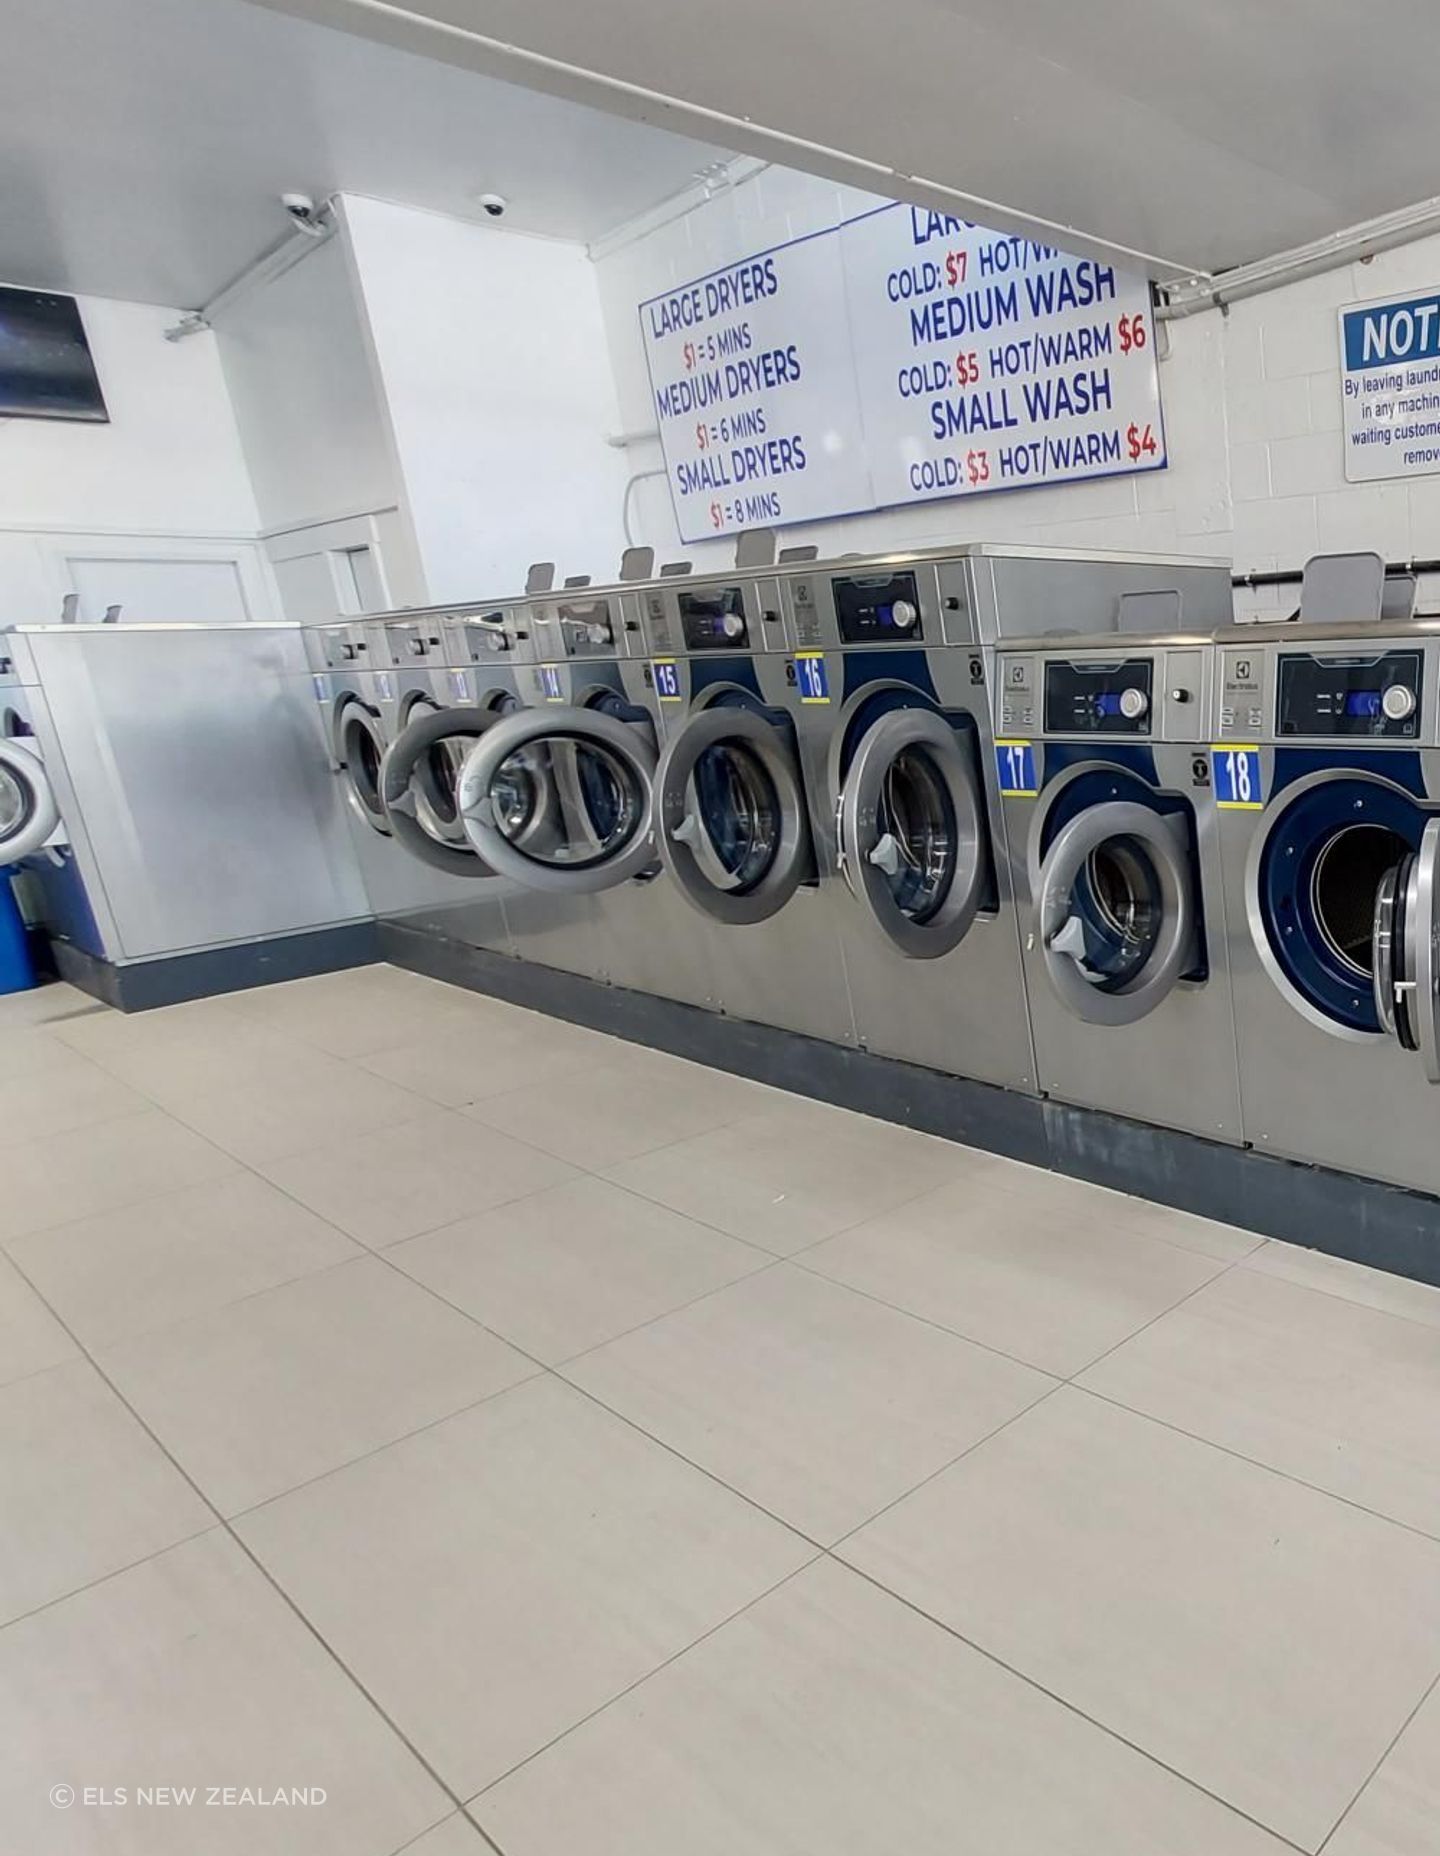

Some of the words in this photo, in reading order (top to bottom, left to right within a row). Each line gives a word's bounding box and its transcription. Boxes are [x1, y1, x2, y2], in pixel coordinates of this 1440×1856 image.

[650, 289, 703, 339] LARGE
[706, 258, 778, 317] DRYERS
[887, 263, 942, 302] COLD:
[946, 251, 967, 291] $7
[911, 282, 1019, 347] MEDIUM
[1025, 261, 1116, 317] WASH
[684, 343, 697, 370] $1
[707, 336, 716, 361] 5
[718, 322, 752, 358] MINS
[898, 360, 952, 397] COLD:
[956, 351, 979, 388] $5
[989, 322, 1112, 379] HOT/WARM
[1118, 313, 1146, 355] $6
[656, 374, 722, 420] MEDIUM
[726, 345, 801, 399] DRYERS
[931, 388, 1018, 440] SMALL
[1023, 367, 1112, 423] WASH
[1345, 379, 1359, 398] By
[1363, 373, 1403, 393] leaving
[696, 423, 709, 451] $1
[720, 418, 729, 441] 6
[731, 408, 766, 438] MINS
[1361, 403, 1372, 419] in
[1375, 402, 1395, 419] any
[910, 454, 964, 491] COLD:
[967, 449, 989, 487] $3
[999, 429, 1121, 478] HOT/WARM
[1127, 422, 1156, 463] $4
[1352, 427, 1391, 446] waiting
[677, 455, 730, 495] SMALL
[734, 435, 806, 484] DRYERS
[710, 502, 724, 529] $1
[734, 499, 744, 522] 8
[746, 492, 781, 519] MINS
[659, 665, 676, 694] 15
[804, 658, 822, 697] 16
[1006, 746, 1025, 789] 17
[1225, 751, 1250, 801] 18
